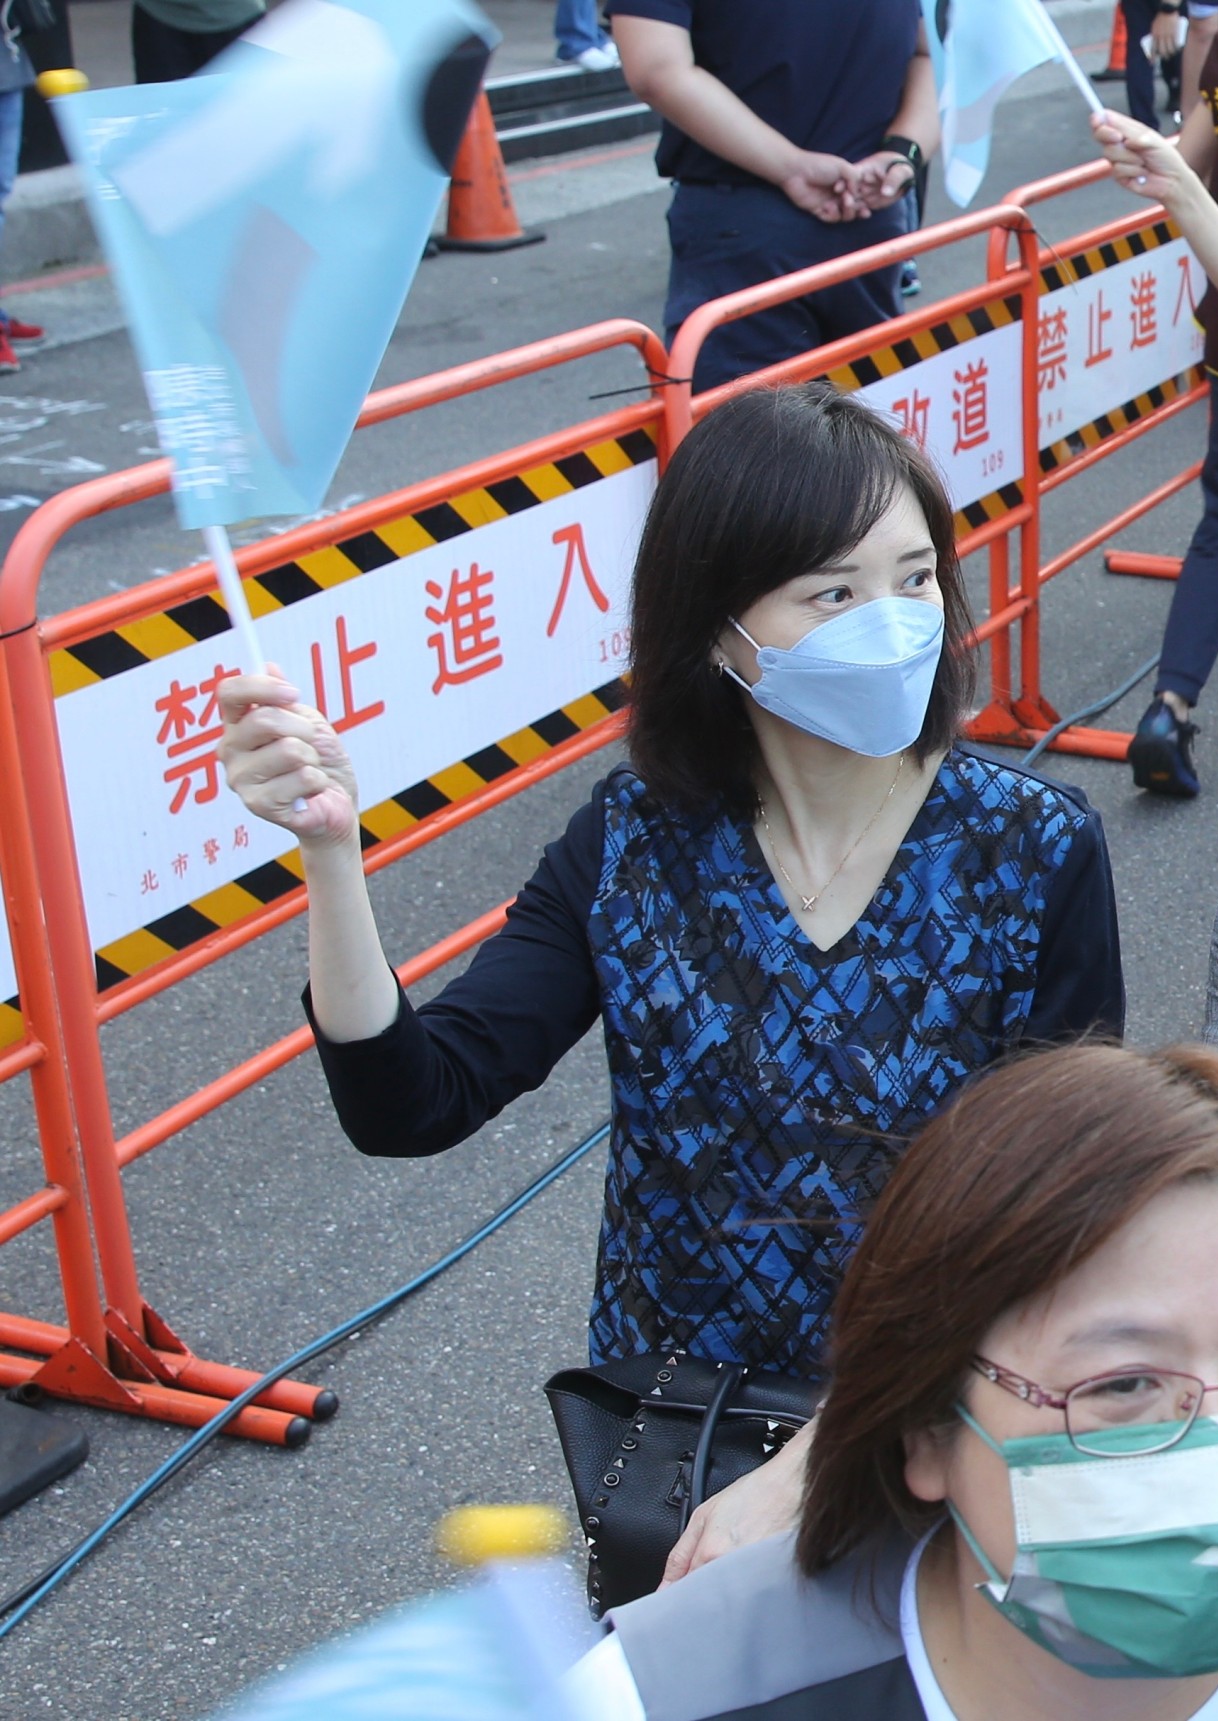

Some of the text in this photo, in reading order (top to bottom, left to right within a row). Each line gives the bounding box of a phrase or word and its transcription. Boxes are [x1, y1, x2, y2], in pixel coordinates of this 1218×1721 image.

[1038, 255, 1197, 394] 禁止進入
[981, 450, 1004, 477] 109
[139, 825, 250, 895] 北市警局
